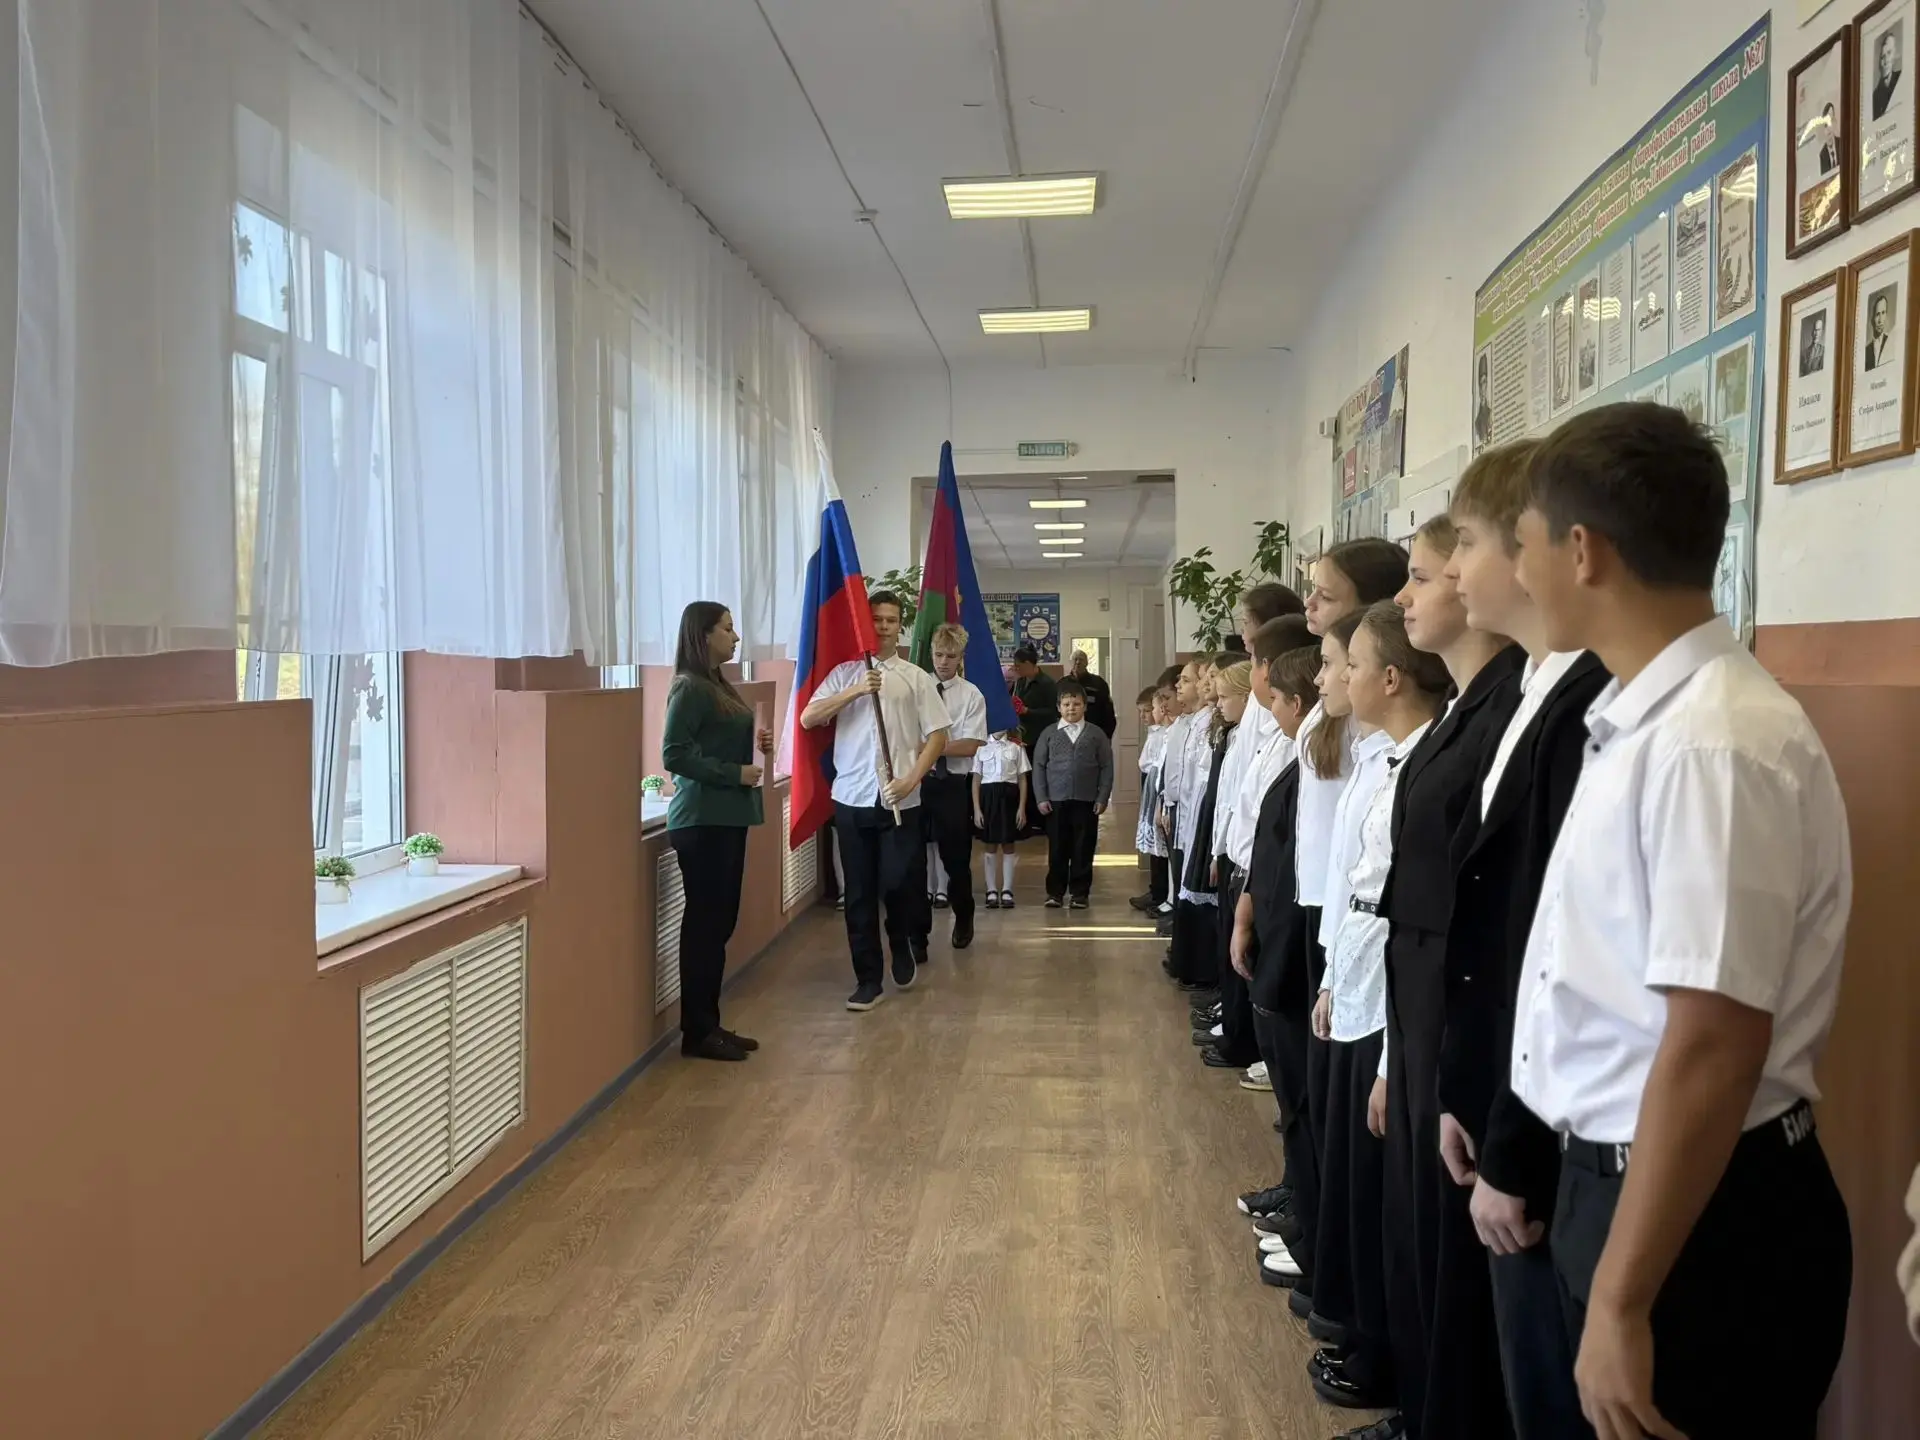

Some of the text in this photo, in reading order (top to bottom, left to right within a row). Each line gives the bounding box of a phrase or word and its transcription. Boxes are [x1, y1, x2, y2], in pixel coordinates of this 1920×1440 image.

[1632, 91, 1707, 174] общеобразовательная
[1710, 64, 1739, 107] школа
[1743, 32, 1767, 79] №27
[1630, 137, 1688, 206] Усть-Лабинский
[1691, 120, 1716, 164] район
[1410, 510, 1415, 527] 8
